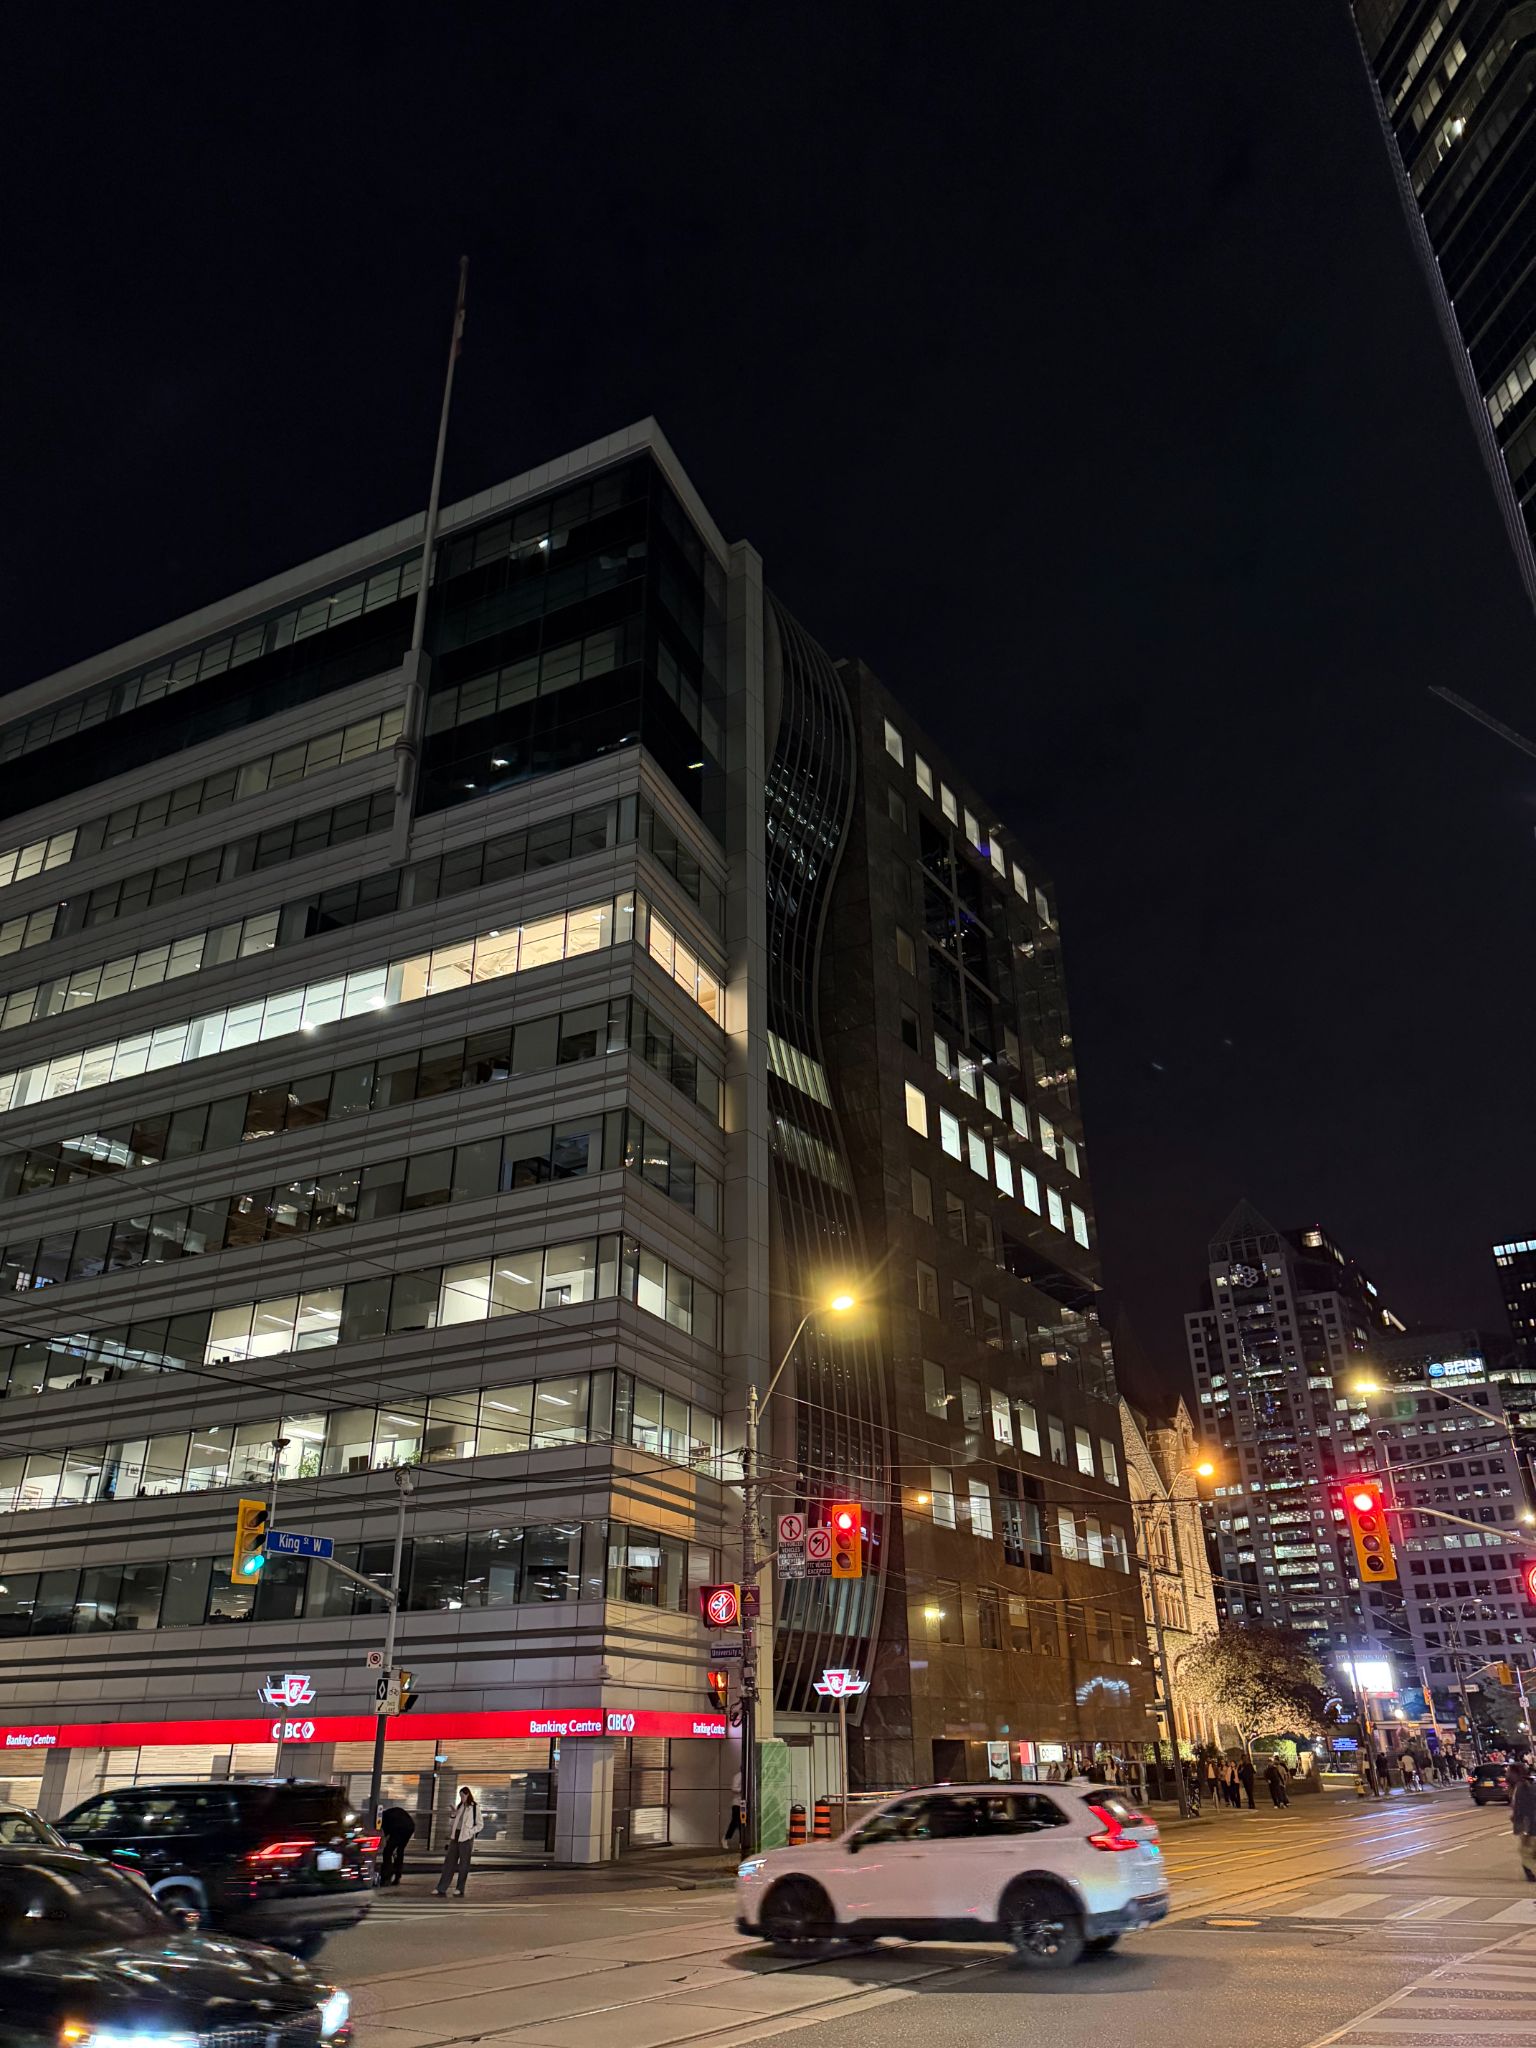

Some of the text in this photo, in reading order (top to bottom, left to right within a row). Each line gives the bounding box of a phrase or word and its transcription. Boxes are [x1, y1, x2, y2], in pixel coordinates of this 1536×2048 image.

[1443, 1358, 1482, 1368] SPIN
[1445, 1366, 1483, 1376] MASTER
[279, 1533, 322, 1553] King St W
[711, 1648, 738, 1657] University
[530, 1719, 601, 1735] Banking Centre
[607, 1713, 626, 1731] CIBC
[692, 1722, 725, 1736] Banking Centre
[272, 1722, 302, 1739] CBC
[6, 1733, 56, 1747] Banking Centre
